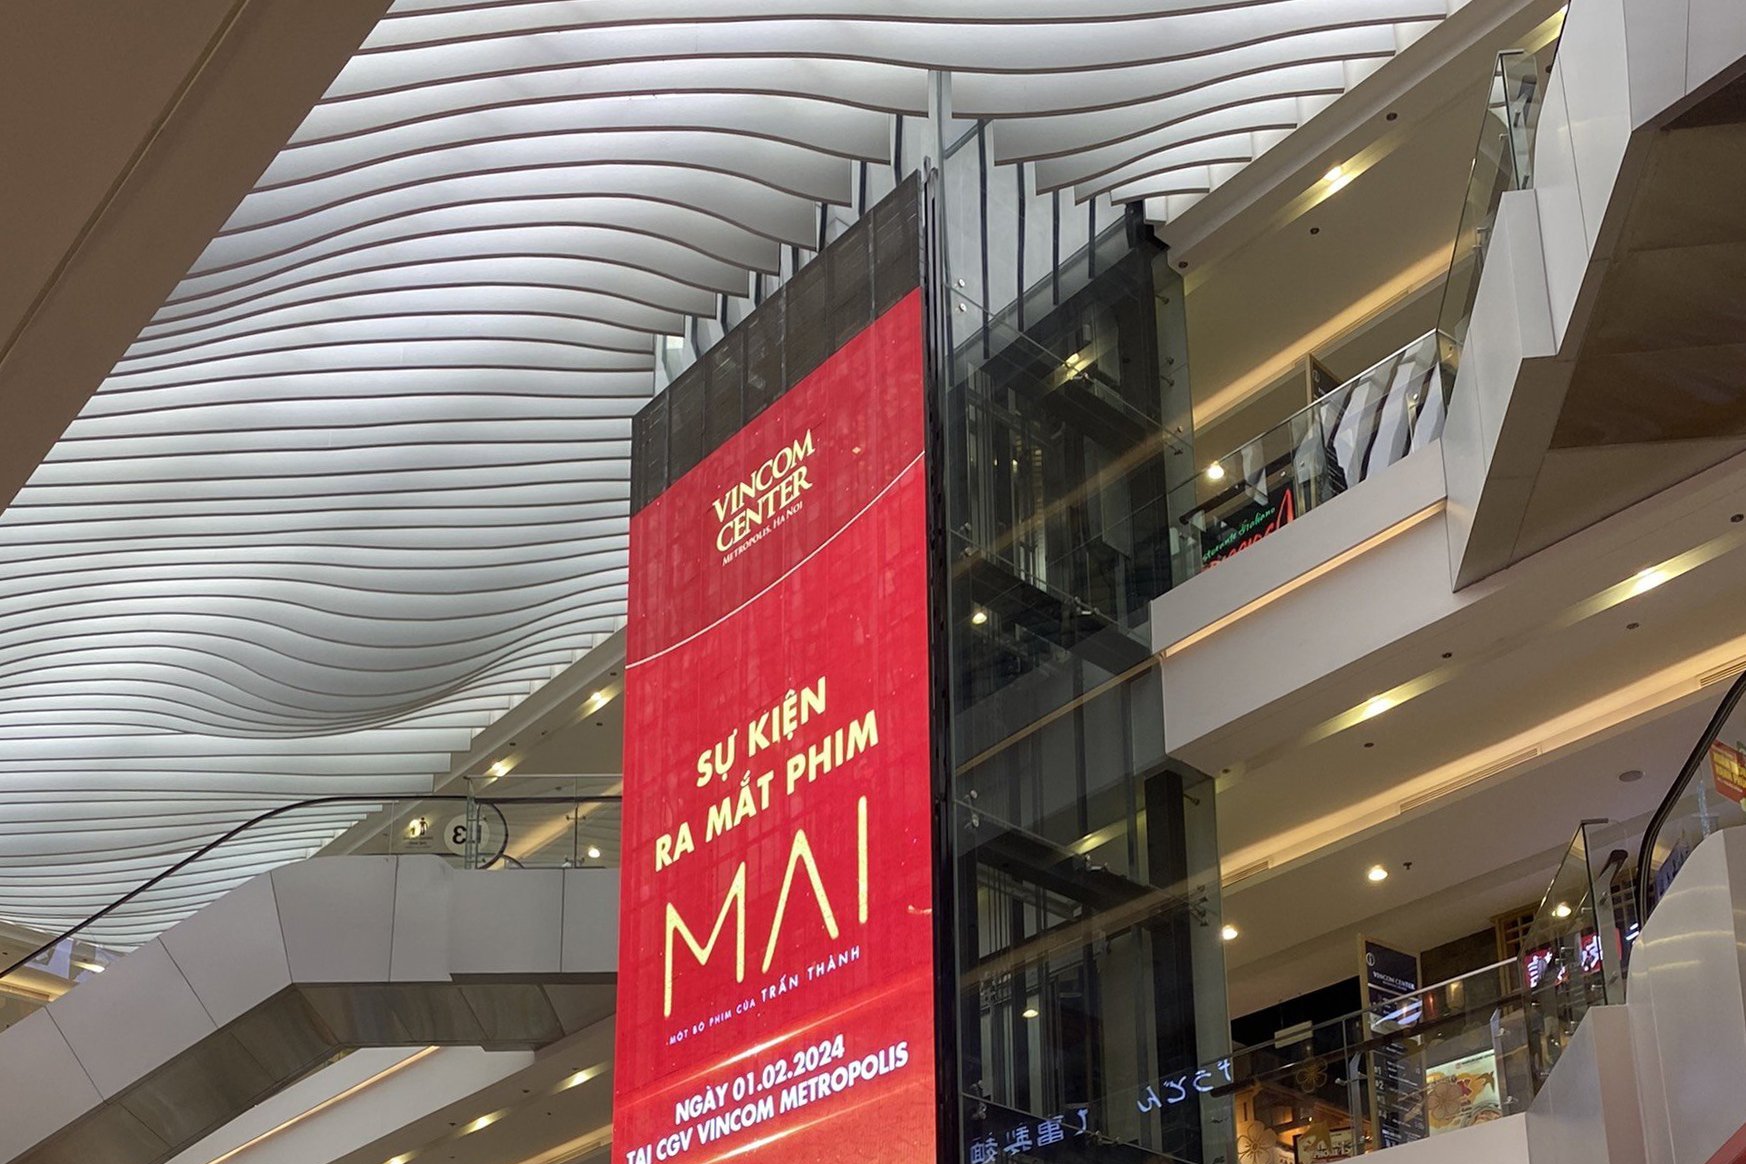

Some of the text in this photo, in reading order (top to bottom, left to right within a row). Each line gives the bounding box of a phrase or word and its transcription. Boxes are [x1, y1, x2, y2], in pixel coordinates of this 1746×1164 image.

[712, 428, 815, 522] VINCOM
[716, 466, 812, 552] CENTER
[696, 675, 826, 788] SỰ KIỆN
[655, 709, 879, 873] RA MẮT PHIM
[663, 795, 868, 1018] MAI
[709, 1010, 733, 1027] PHIM
[736, 998, 756, 1014] CỦA
[761, 973, 799, 1003] TRẤN
[807, 945, 861, 981] THÀNH
[656, 1128, 693, 1161] CGV
[698, 1099, 774, 1145] VINCOM
[779, 1041, 909, 1114] METROPOLIS
[675, 1034, 845, 1125] NGÀY 01.02.2024
